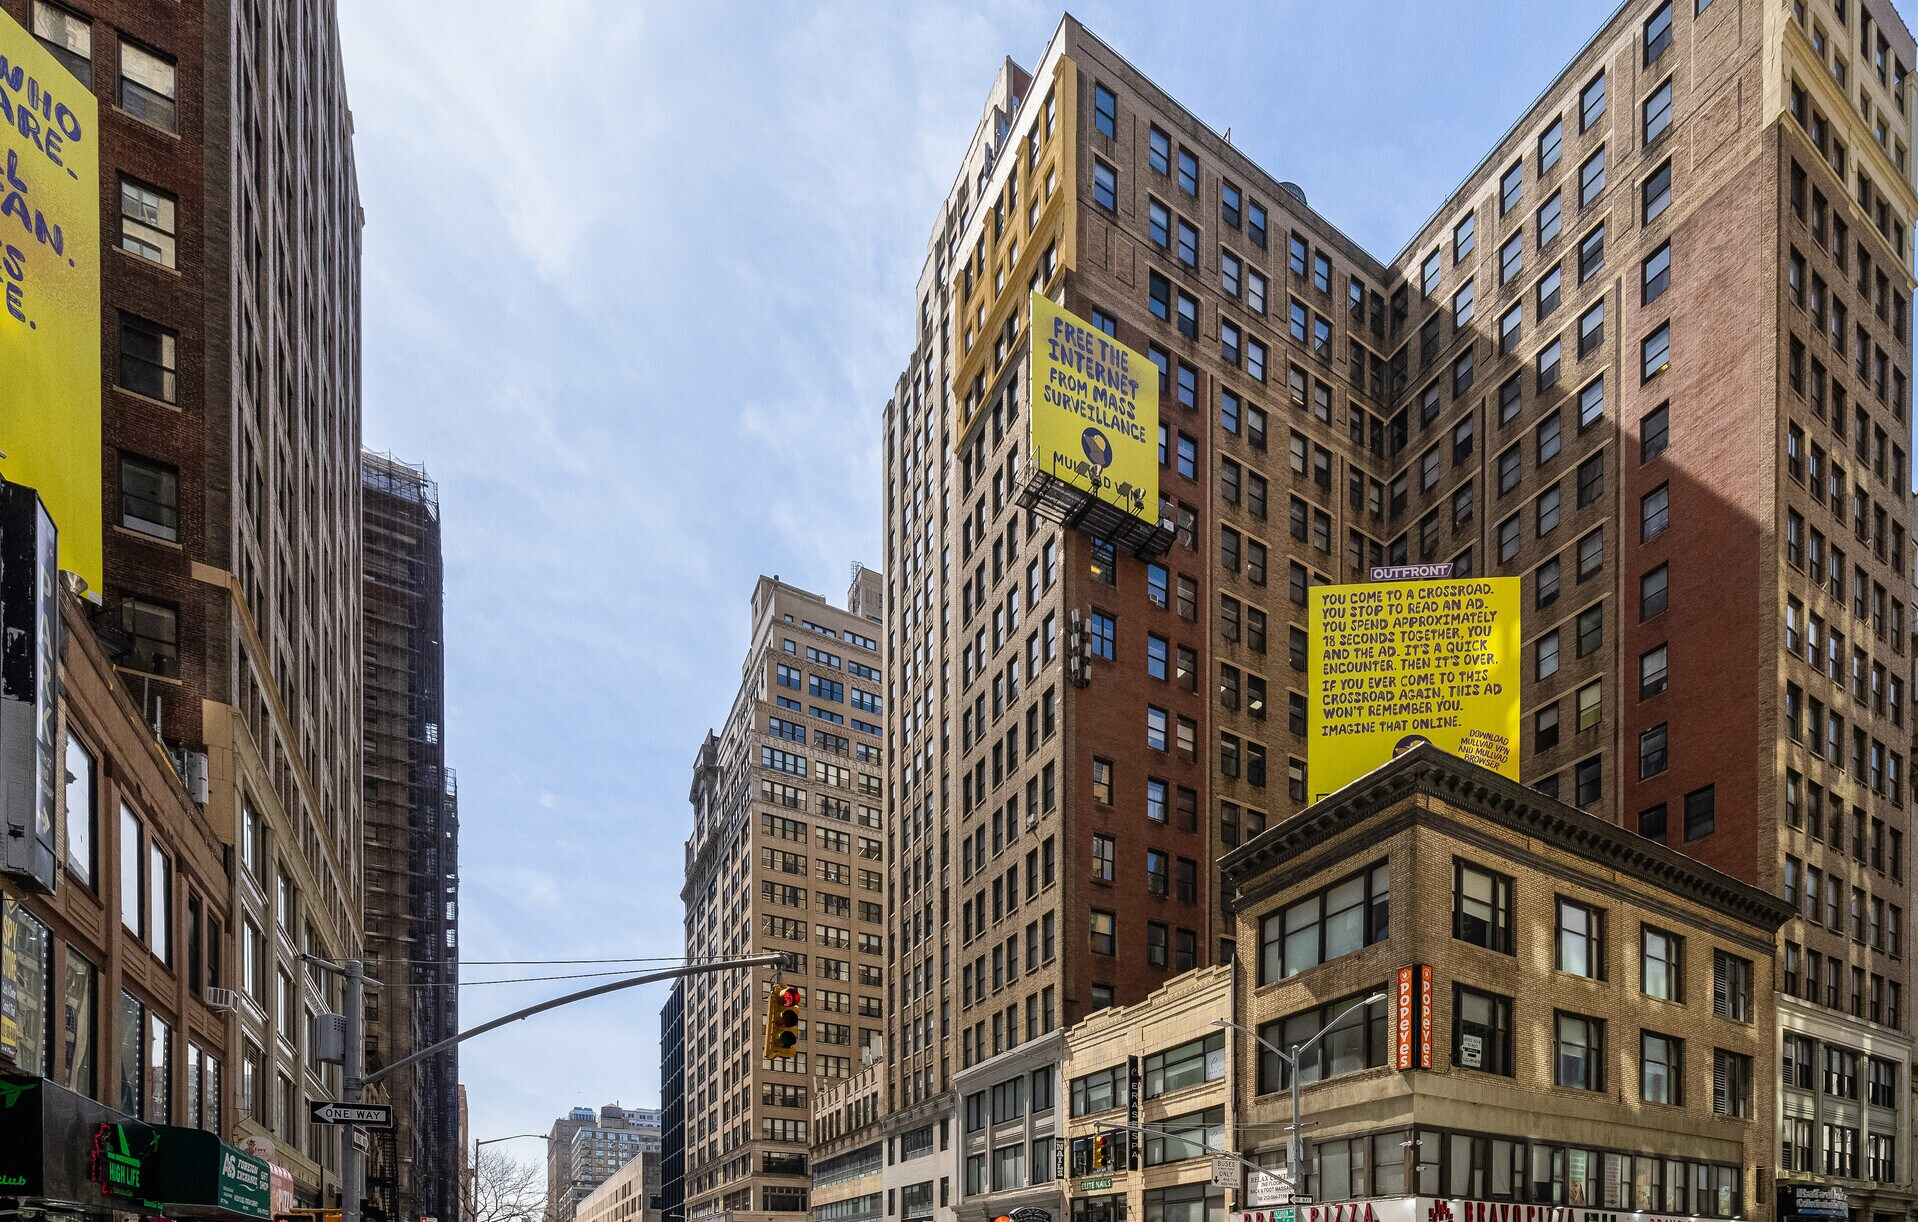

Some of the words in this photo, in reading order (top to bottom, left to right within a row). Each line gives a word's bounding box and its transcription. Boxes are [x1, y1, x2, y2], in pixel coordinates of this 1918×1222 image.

[1054, 316, 1094, 352] FREE
[1097, 338, 1129, 373] THE
[1048, 338, 1139, 400] INTERNET
[1050, 367, 1088, 398] FROM
[1093, 385, 1136, 421] MASS
[1044, 384, 1146, 444] SURVEILLANCE
[1373, 565, 1448, 579] OUTFRONT
[1322, 594, 1346, 606] YOU
[1350, 591, 1382, 604] COME
[1386, 590, 1402, 602] TO
[1406, 589, 1414, 600] A
[1418, 584, 1494, 599] CROSSROAD.
[1322, 607, 1346, 619] YOU
[1350, 605, 1383, 618] STOP
[1387, 603, 1403, 616] TO
[1408, 601, 1439, 614] READ
[1443, 599, 1461, 611] AN
[1466, 598, 1488, 610] AD.
[1322, 621, 1346, 633] YOU
[1351, 619, 1388, 631] SPEND
[1393, 611, 1497, 629] APPROXIMATELY
[1323, 635, 1335, 647] 18
[1339, 631, 1395, 646] SECONDS
[1400, 628, 1464, 643] TOGETHER,
[1468, 625, 1491, 638] YOU
[1323, 649, 1350, 661] AND
[1353, 647, 1374, 659] THE
[1378, 646, 1400, 658] AD.
[1404, 643, 1430, 656] IT'S
[1434, 643, 1442, 654] A
[1446, 639, 1487, 654] QUICK
[1323, 660, 1396, 675] ENCOUNTER.
[1400, 657, 1430, 671] THEN
[1435, 655, 1460, 668] IT'S
[1464, 653, 1498, 665] OVER.
[1322, 680, 1336, 692] IF
[1340, 678, 1364, 691] YOU
[1369, 676, 1396, 689] EVER
[1401, 673, 1435, 687] COME
[1439, 671, 1455, 684] TO
[1459, 669, 1488, 683] THIS
[1323, 691, 1395, 706] CROSSROAD
[1399, 687, 1445, 701] AGAIN,
[1448, 684, 1480, 698] THIS
[1484, 683, 1502, 695] AD
[1323, 706, 1364, 719] WON'T
[1368, 702, 1432, 717] REMEMBER
[1436, 700, 1463, 712] YOU.
[1322, 722, 1375, 737] IMAGINE
[1379, 720, 1408, 732] THAT
[1412, 716, 1462, 730] ONLINE.
[1469, 729, 1509, 746] DOWNLOAD
[1457, 745, 1473, 755] AND
[1475, 748, 1509, 765] MULLVAD
[1460, 737, 1493, 751] MULLVAD
[1495, 743, 1511, 756] VPN
[1464, 753, 1500, 771] BROWSER
[2, 914, 18, 951] SPY
[325, 1108, 351, 1119] ONE
[356, 1110, 381, 1121] WAY
[1056, 1143, 1064, 1177] NAILS
[1217, 1160, 1236, 1168] BUSES
[1081, 1182, 1095, 1190] ELITE
[1095, 1180, 1111, 1188] NAILS
